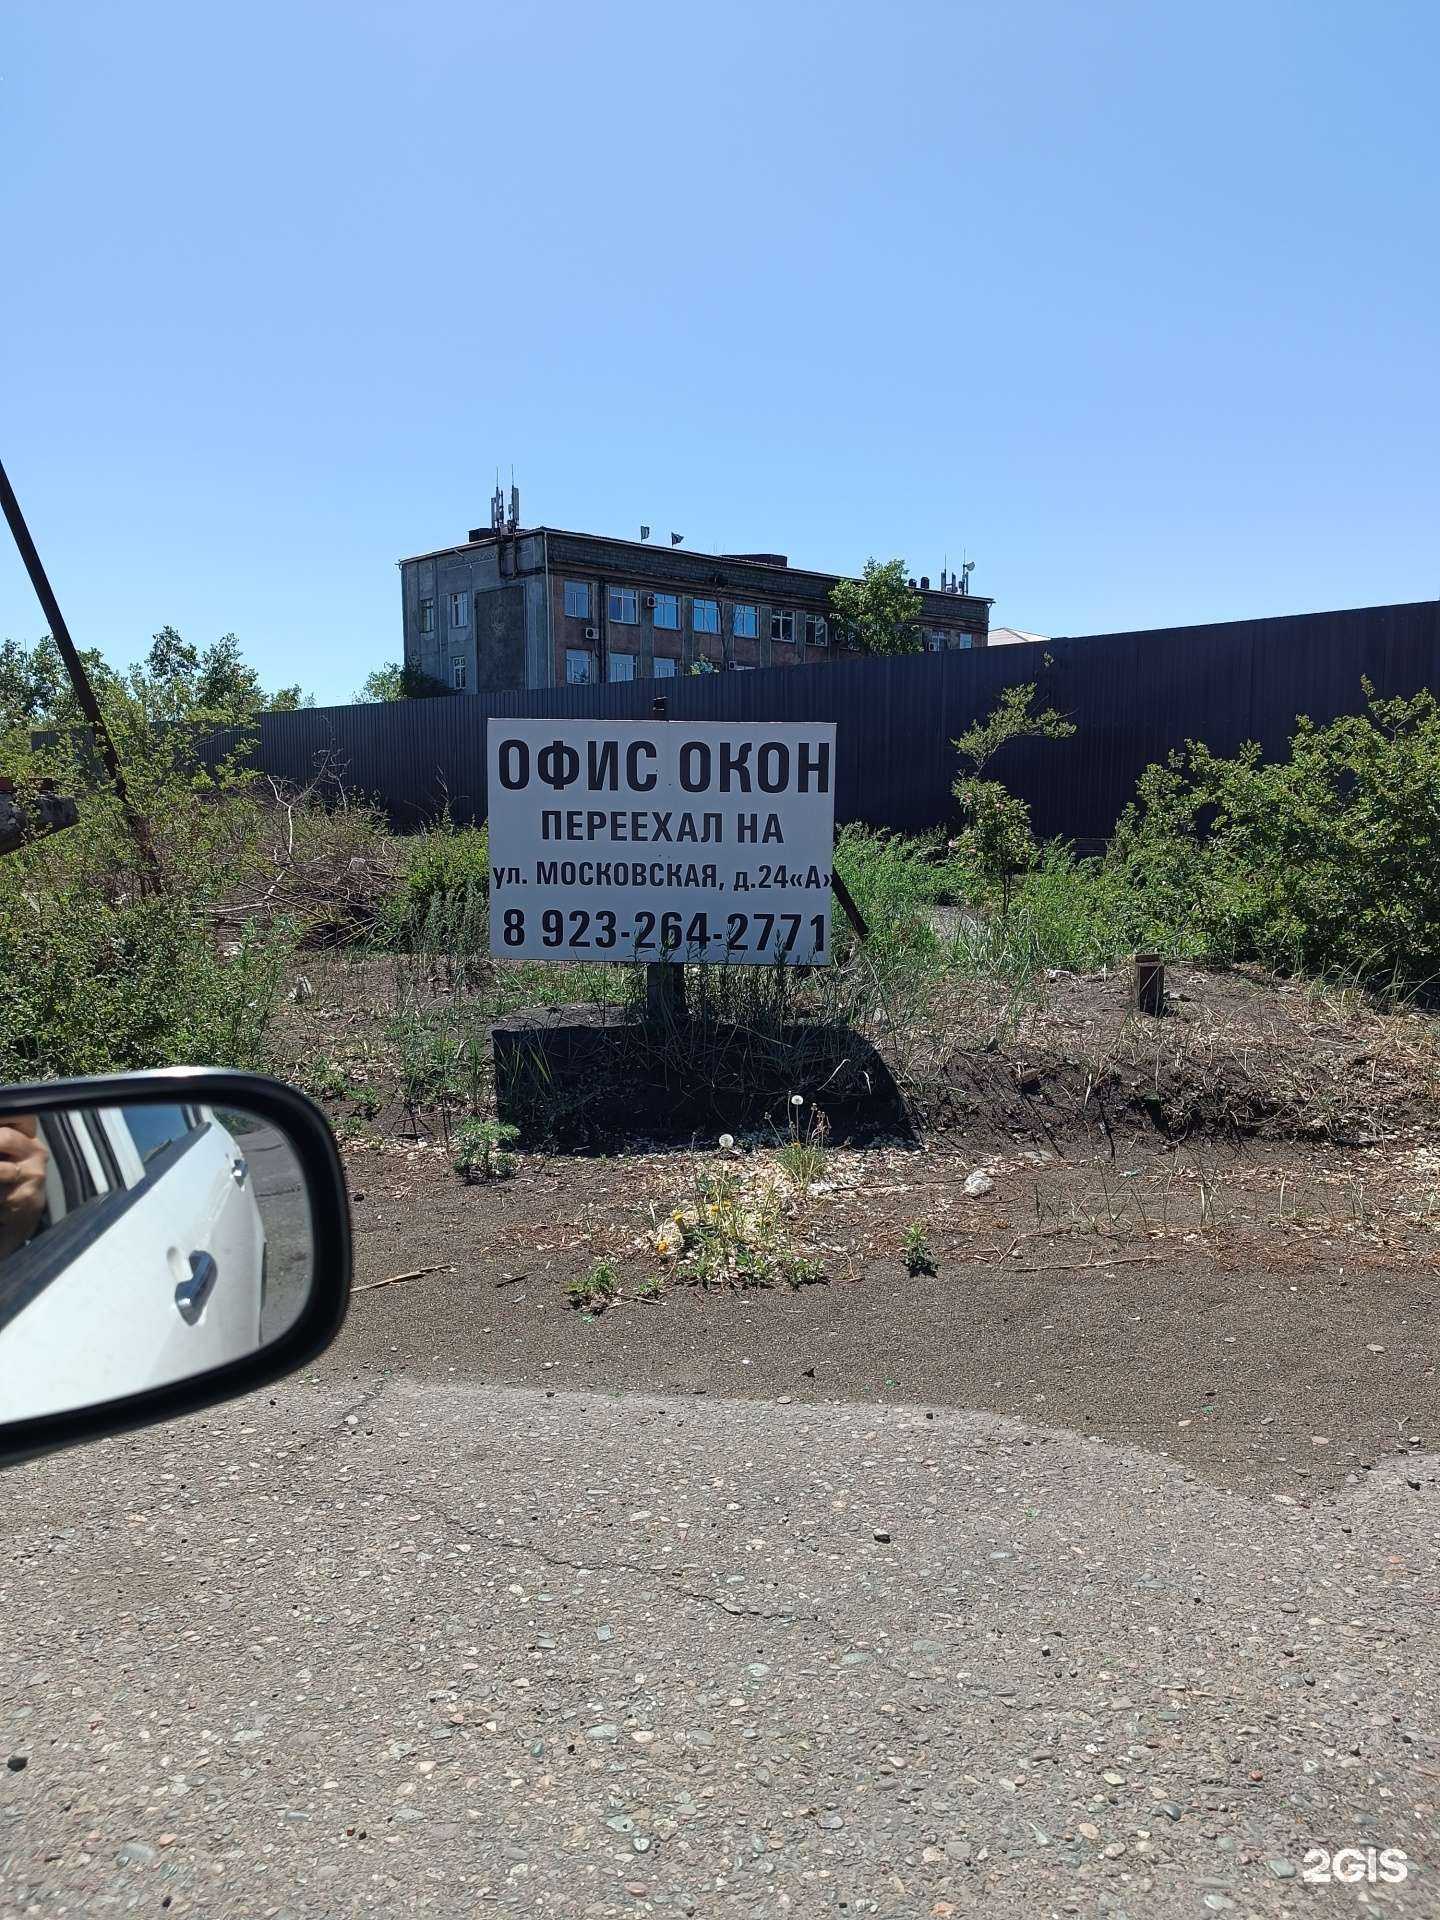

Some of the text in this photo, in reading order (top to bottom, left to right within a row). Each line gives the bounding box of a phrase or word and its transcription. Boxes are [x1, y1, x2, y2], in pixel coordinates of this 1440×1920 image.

[498, 739, 830, 793] ОФИС ОКОН
[541, 810, 784, 844] ПЕРЕЕХАЛ НА
[492, 865, 528, 889] ул.
[536, 861, 724, 892] МОСКОВСКАЯ,
[503, 909, 826, 952] 8 923-264-2771
